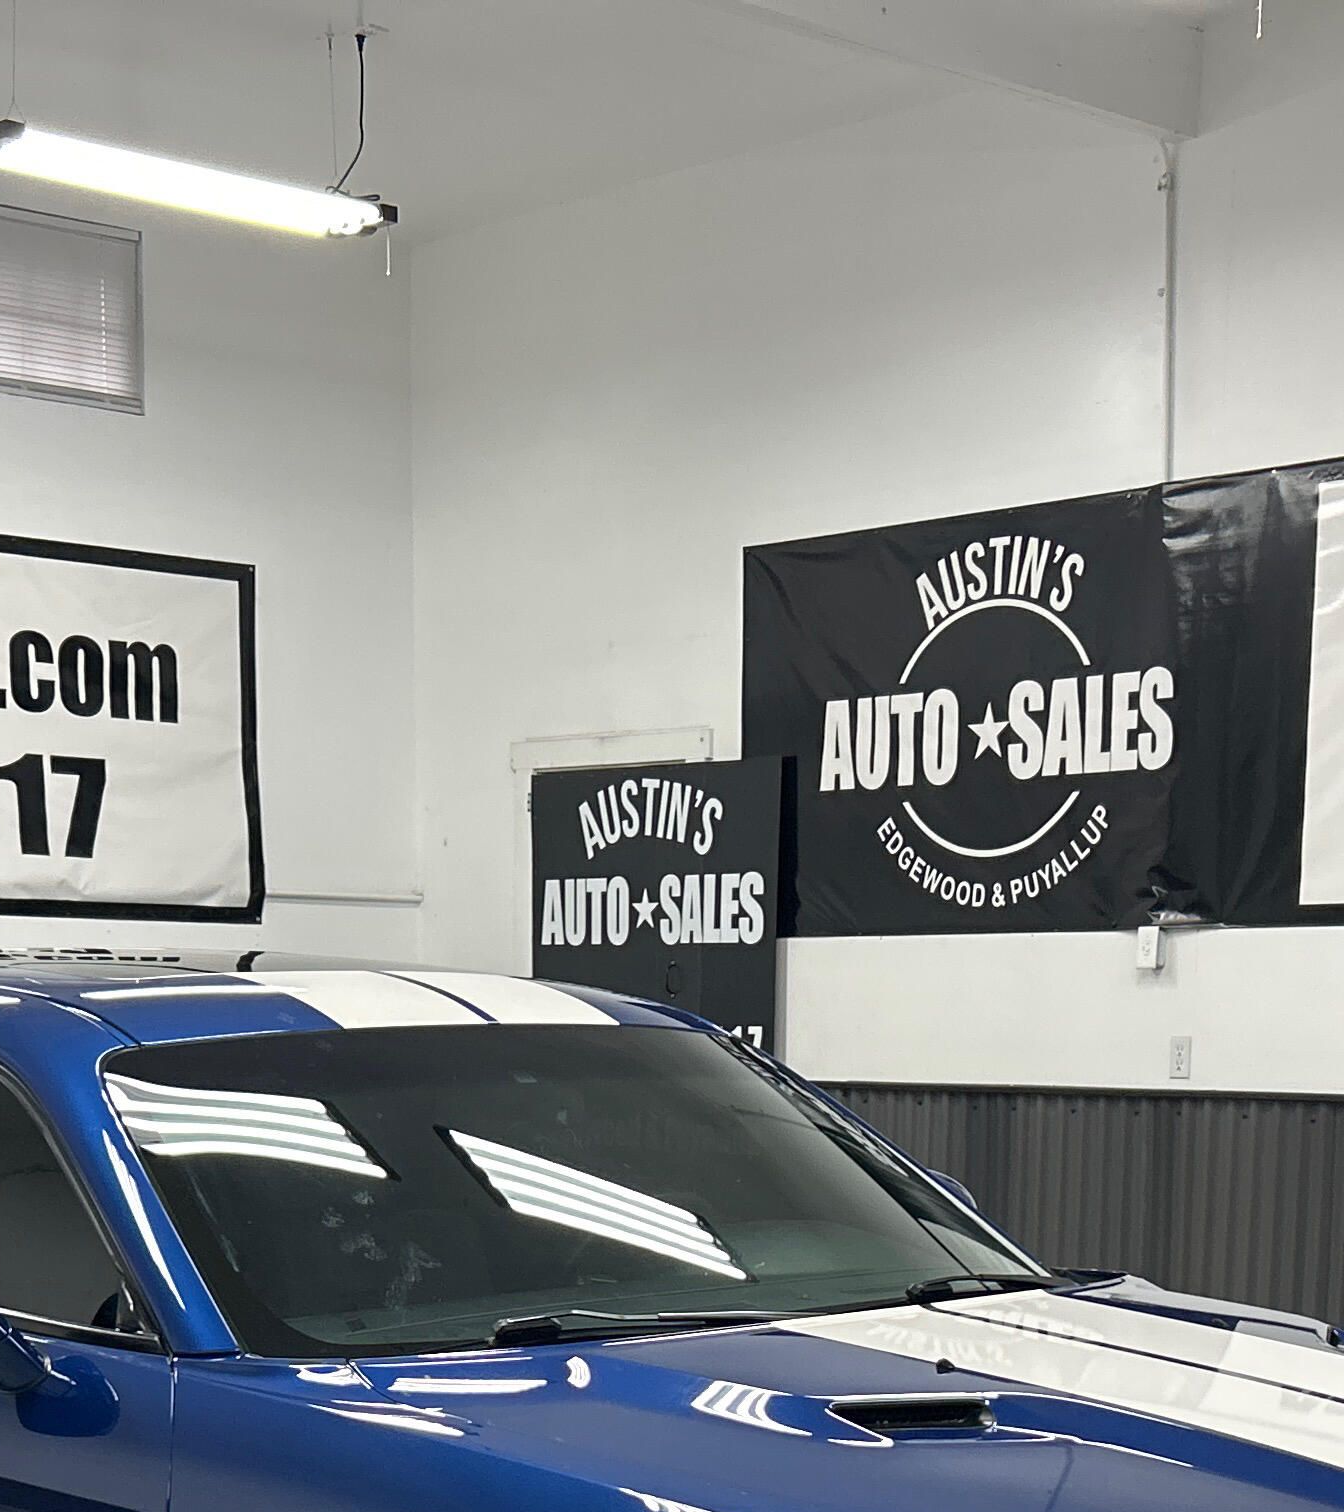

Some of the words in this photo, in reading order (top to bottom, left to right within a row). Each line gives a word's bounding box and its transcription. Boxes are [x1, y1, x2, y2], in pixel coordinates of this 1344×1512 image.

[914, 535, 1084, 630] AUSTIN'S
[819, 687, 957, 792] AUTO
[1006, 666, 1174, 780] SALES
[578, 778, 723, 860] AUSTIN'S
[876, 818, 986, 908] EDGEWOOD
[992, 882, 1005, 907] &
[1010, 804, 1110, 904] PUYALLUP
[541, 875, 630, 946] AUTO
[659, 871, 765, 945] SALES
